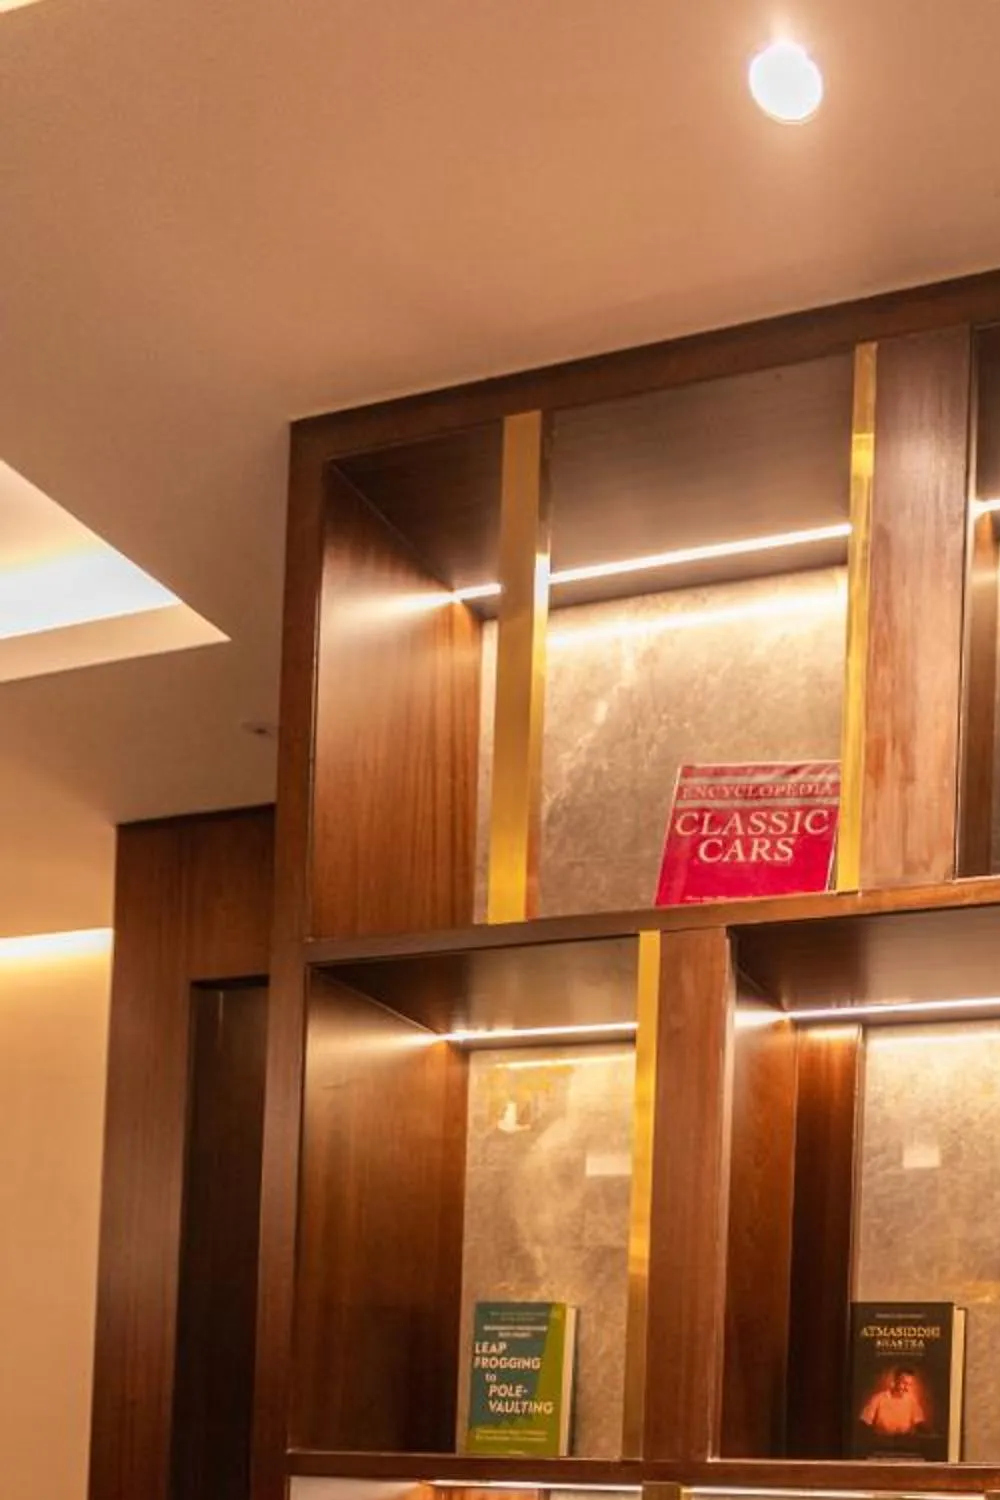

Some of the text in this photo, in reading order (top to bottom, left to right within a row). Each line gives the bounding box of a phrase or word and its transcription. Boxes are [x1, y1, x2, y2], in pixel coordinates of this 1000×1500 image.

[682, 782, 833, 799] ENCYCLOPEDIA
[675, 809, 829, 836] CLASSIC
[698, 837, 796, 864] CARS
[474, 1341, 508, 1354] LEAP
[474, 1356, 541, 1369] FROGGING
[485, 1373, 497, 1383] to
[488, 1400, 554, 1415] VAULTING
